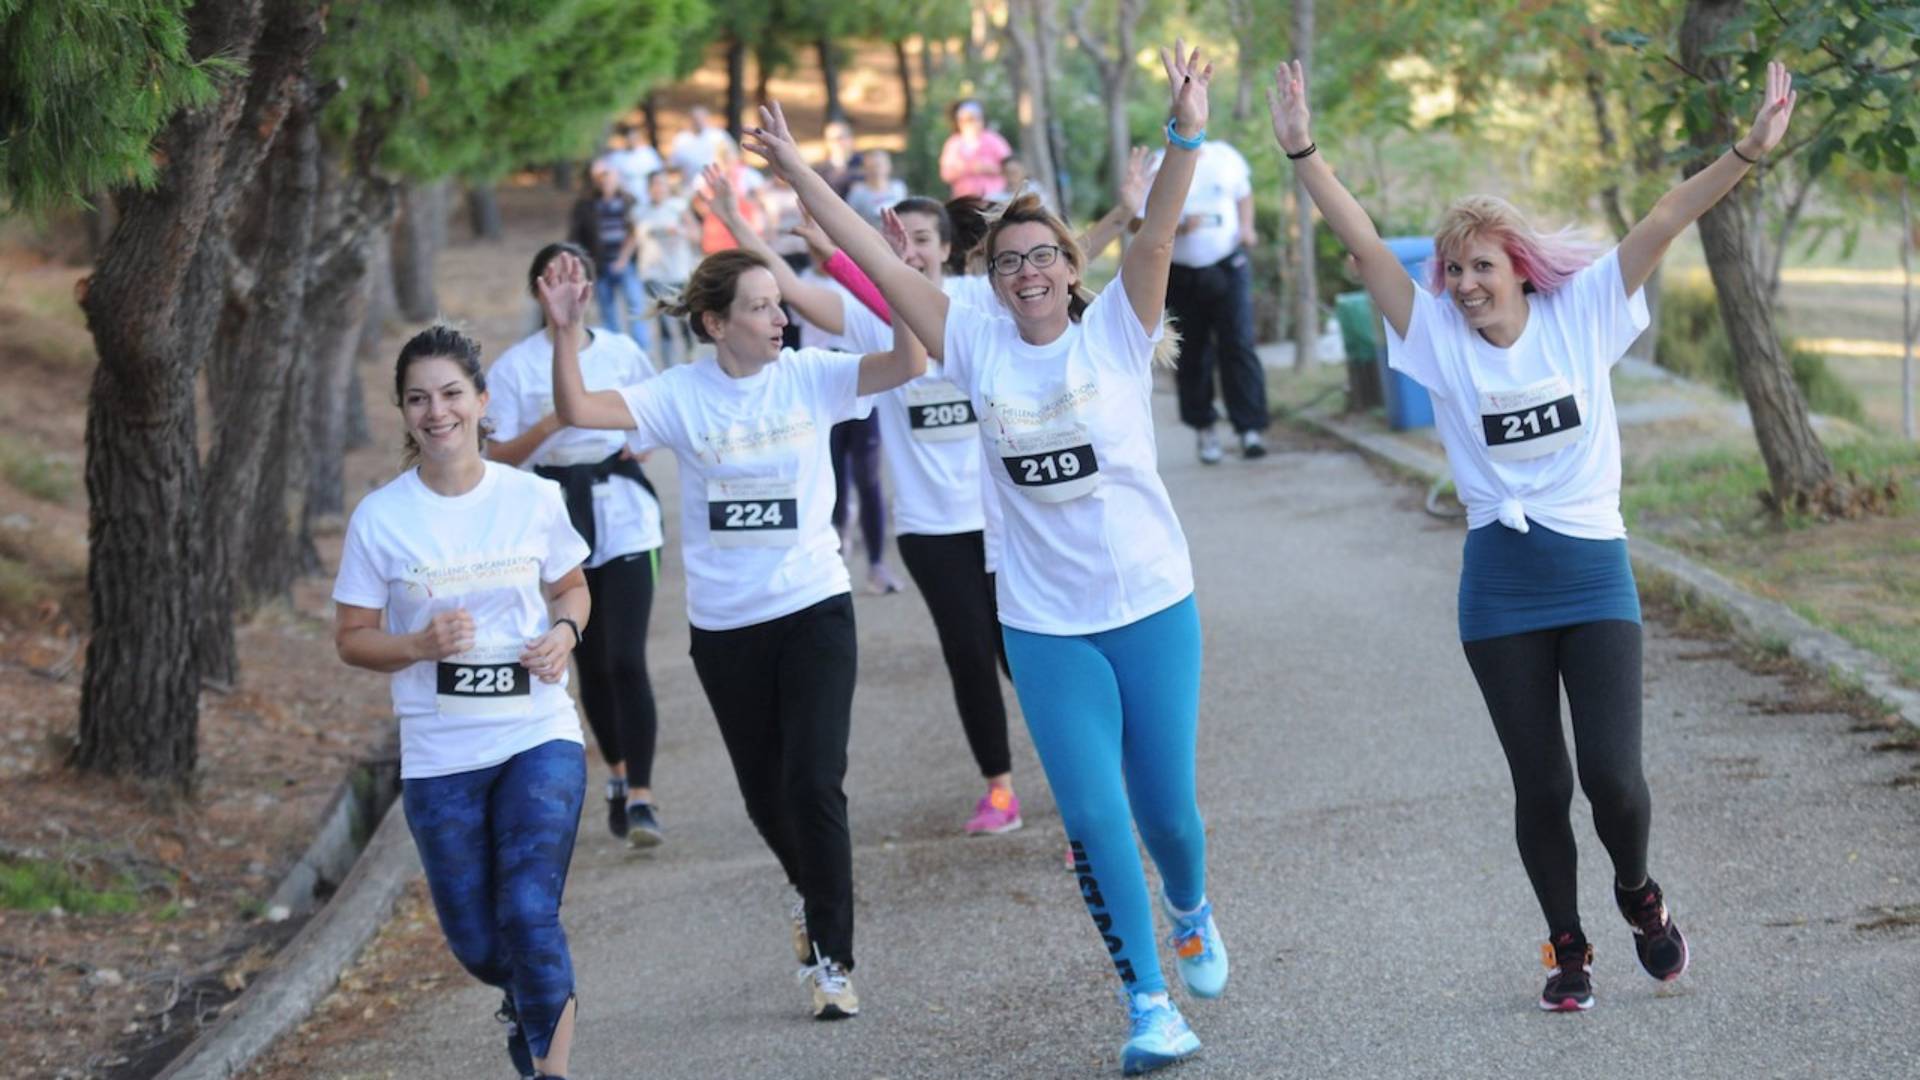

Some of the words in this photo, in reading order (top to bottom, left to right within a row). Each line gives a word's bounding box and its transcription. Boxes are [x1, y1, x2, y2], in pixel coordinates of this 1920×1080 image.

[922, 403, 969, 427] 209
[1501, 404, 1561, 440] 211
[1020, 452, 1081, 482] 219
[725, 502, 783, 527] 224
[454, 667, 515, 693] 228
